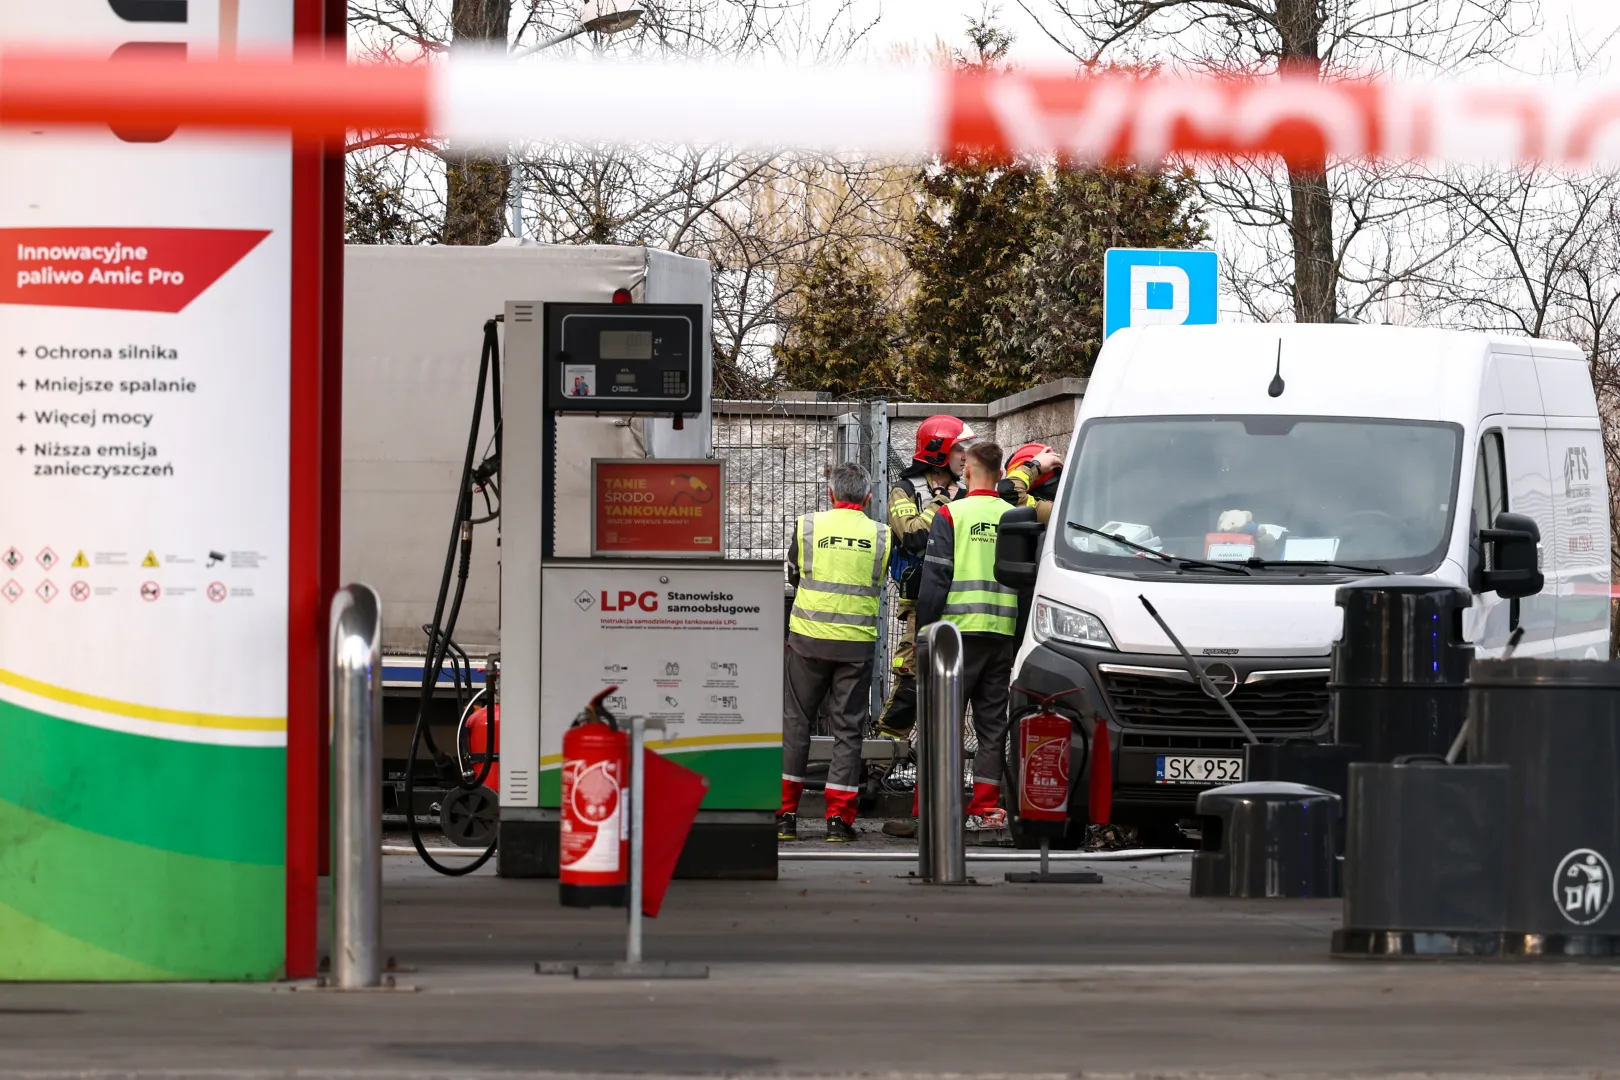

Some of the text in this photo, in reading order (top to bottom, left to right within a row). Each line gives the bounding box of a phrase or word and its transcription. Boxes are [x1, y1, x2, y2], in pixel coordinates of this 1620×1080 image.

[17, 242, 148, 263] Innowacyjne
[17, 267, 184, 288] paliwo Amic Pro
[1130, 264, 1190, 325] P
[35, 345, 112, 360] Ochrona
[118, 345, 178, 360] silnika
[35, 377, 113, 394] Mniejsze
[120, 378, 197, 395] spalanie
[35, 410, 96, 428] Więcej
[103, 413, 153, 428] mocy
[34, 443, 91, 457] Niższa
[97, 442, 157, 460] emisja
[34, 461, 174, 479] zanieczyszczeń
[1568, 446, 1589, 481] FTS
[604, 479, 647, 489] TANIE
[604, 489, 655, 503] ŚRODO
[604, 506, 702, 517] TANKOWANIE
[830, 536, 872, 549] FTS
[601, 590, 659, 613] LPG
[667, 592, 734, 602] Stanowisko
[667, 603, 761, 615] samoobsługowe
[634, 618, 684, 626] samodzielnego
[1169, 758, 1240, 780] SK 952
